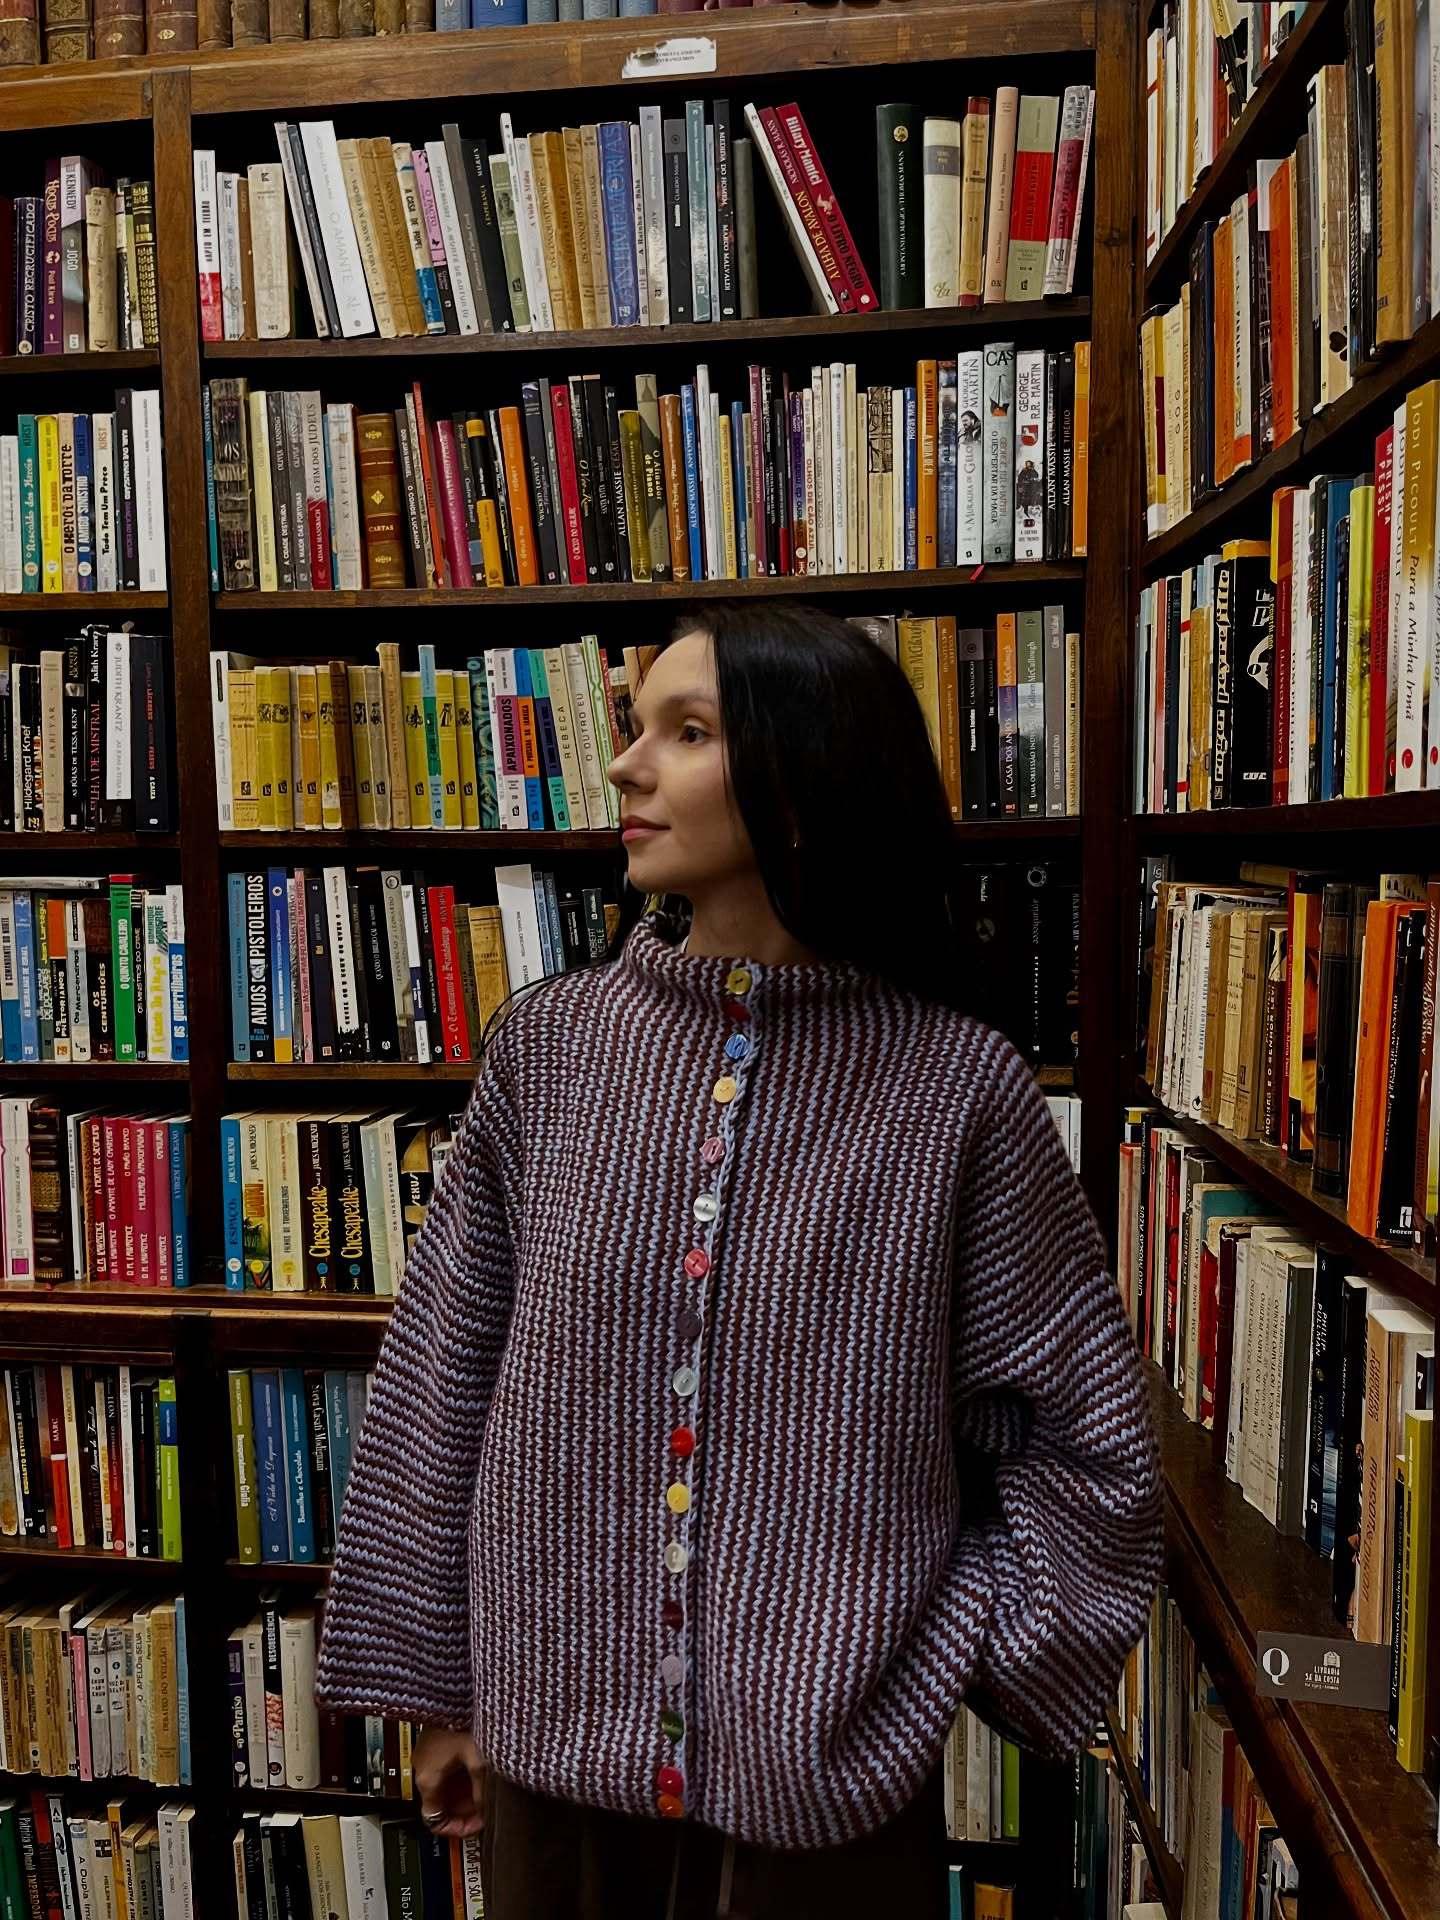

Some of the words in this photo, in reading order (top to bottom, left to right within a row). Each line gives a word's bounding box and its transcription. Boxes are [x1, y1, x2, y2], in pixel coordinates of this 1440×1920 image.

[719, 132, 727, 162] MEDIDA
[786, 115, 804, 149] Hilary
[897, 150, 905, 174] MANN
[65, 174, 77, 210] KENNEDY
[720, 181, 728, 206] HOMEM
[898, 174, 906, 204] THOMAS
[406, 196, 416, 213] CASA
[413, 230, 422, 250] PAPEL
[795, 191, 820, 230] AVALON
[22, 203, 35, 291] RECRUCIFICADO
[812, 230, 826, 244] DE
[899, 232, 907, 270] MONTANHA
[66, 249, 78, 271] JOGO
[722, 250, 731, 291] MALVALDI
[820, 246, 837, 271] ILHA
[24, 294, 35, 332] CRISTO
[968, 358, 979, 408] MARTIN
[1018, 372, 1030, 412] GEORGE
[1030, 363, 1040, 398] MARTIN
[274, 416, 283, 446] MANNING
[306, 404, 318, 446] JUDEUS
[400, 428, 408, 441] DON
[1411, 402, 1423, 449] JODI
[276, 450, 284, 471] OLIVIA
[310, 448, 319, 465] DOS
[401, 442, 410, 455] JUAN
[1062, 448, 1070, 478] MASSIE
[312, 466, 320, 484] FIM
[402, 456, 412, 478] MANUEL
[645, 468, 654, 497] Pianos
[653, 461, 664, 500] Afinador
[806, 458, 814, 490] OLHOS
[1382, 442, 1394, 525] MARISHA
[76, 476, 88, 514] SINISTRO
[408, 492, 416, 512] CONDE
[614, 471, 624, 504] MASSIE
[1048, 482, 1056, 510] ALLAN
[1062, 479, 1070, 506] ALLAN
[1377, 461, 1387, 516] PESSL
[1408, 461, 1420, 545] PICOULT
[294, 492, 304, 524] FORTUNAS
[617, 504, 626, 537] ALLAN
[808, 506, 816, 525] CÃO
[990, 498, 998, 524] MAGIA
[78, 515, 90, 544] AMIGO
[296, 524, 304, 538] DAS
[409, 514, 421, 549] LUCANOR
[808, 526, 816, 550] AZUL
[316, 541, 324, 563] ADAM
[1404, 554, 1420, 602] Para
[1404, 619, 1419, 674] Minha
[113, 656, 124, 690] JUDITH
[113, 692, 124, 732] KRANTZ
[576, 693, 584, 706] EU
[1404, 680, 1418, 720] Irmã
[70, 708, 78, 729] KENT
[501, 698, 516, 771] APAIXONADOS
[557, 705, 572, 758] REBECA
[579, 712, 591, 750] OUTRO
[1004, 718, 1012, 744] ANJOS
[20, 725, 32, 752] Knef
[1005, 746, 1013, 762] DOS
[1214, 710, 1228, 782] roger
[23, 755, 33, 811] Hildegard
[1006, 764, 1014, 785] CASA
[248, 875, 266, 956] PISTOLEIROS
[118, 919, 129, 956] CAVALEIRO
[587, 928, 597, 958] ROBERT
[73, 950, 82, 1011] Mercenários
[120, 957, 130, 984] QUINTO
[170, 954, 187, 1022] guerrilheiros
[58, 971, 68, 1038] PRETORIANOS
[98, 963, 108, 1034] CENTURIÕES
[250, 986, 268, 1026] ANJOS
[306, 1186, 332, 1258] Chesapeake
[338, 1186, 364, 1259] Chesapeake
[1314, 1302, 1323, 1356] PULLMAN
[1320, 1312, 1328, 1352] PHILIP
[52, 1418, 60, 1442] MARC
[314, 1407, 324, 1431] Casati
[294, 1450, 304, 1485] Chocolate
[314, 1432, 328, 1472] Modignani
[266, 1610, 277, 1662] DESOBEDIÊNCIA
[1262, 1647, 1290, 1686] Q
[1324, 1675, 1340, 1684] COSTA
[232, 1696, 244, 1738] Paraíso
